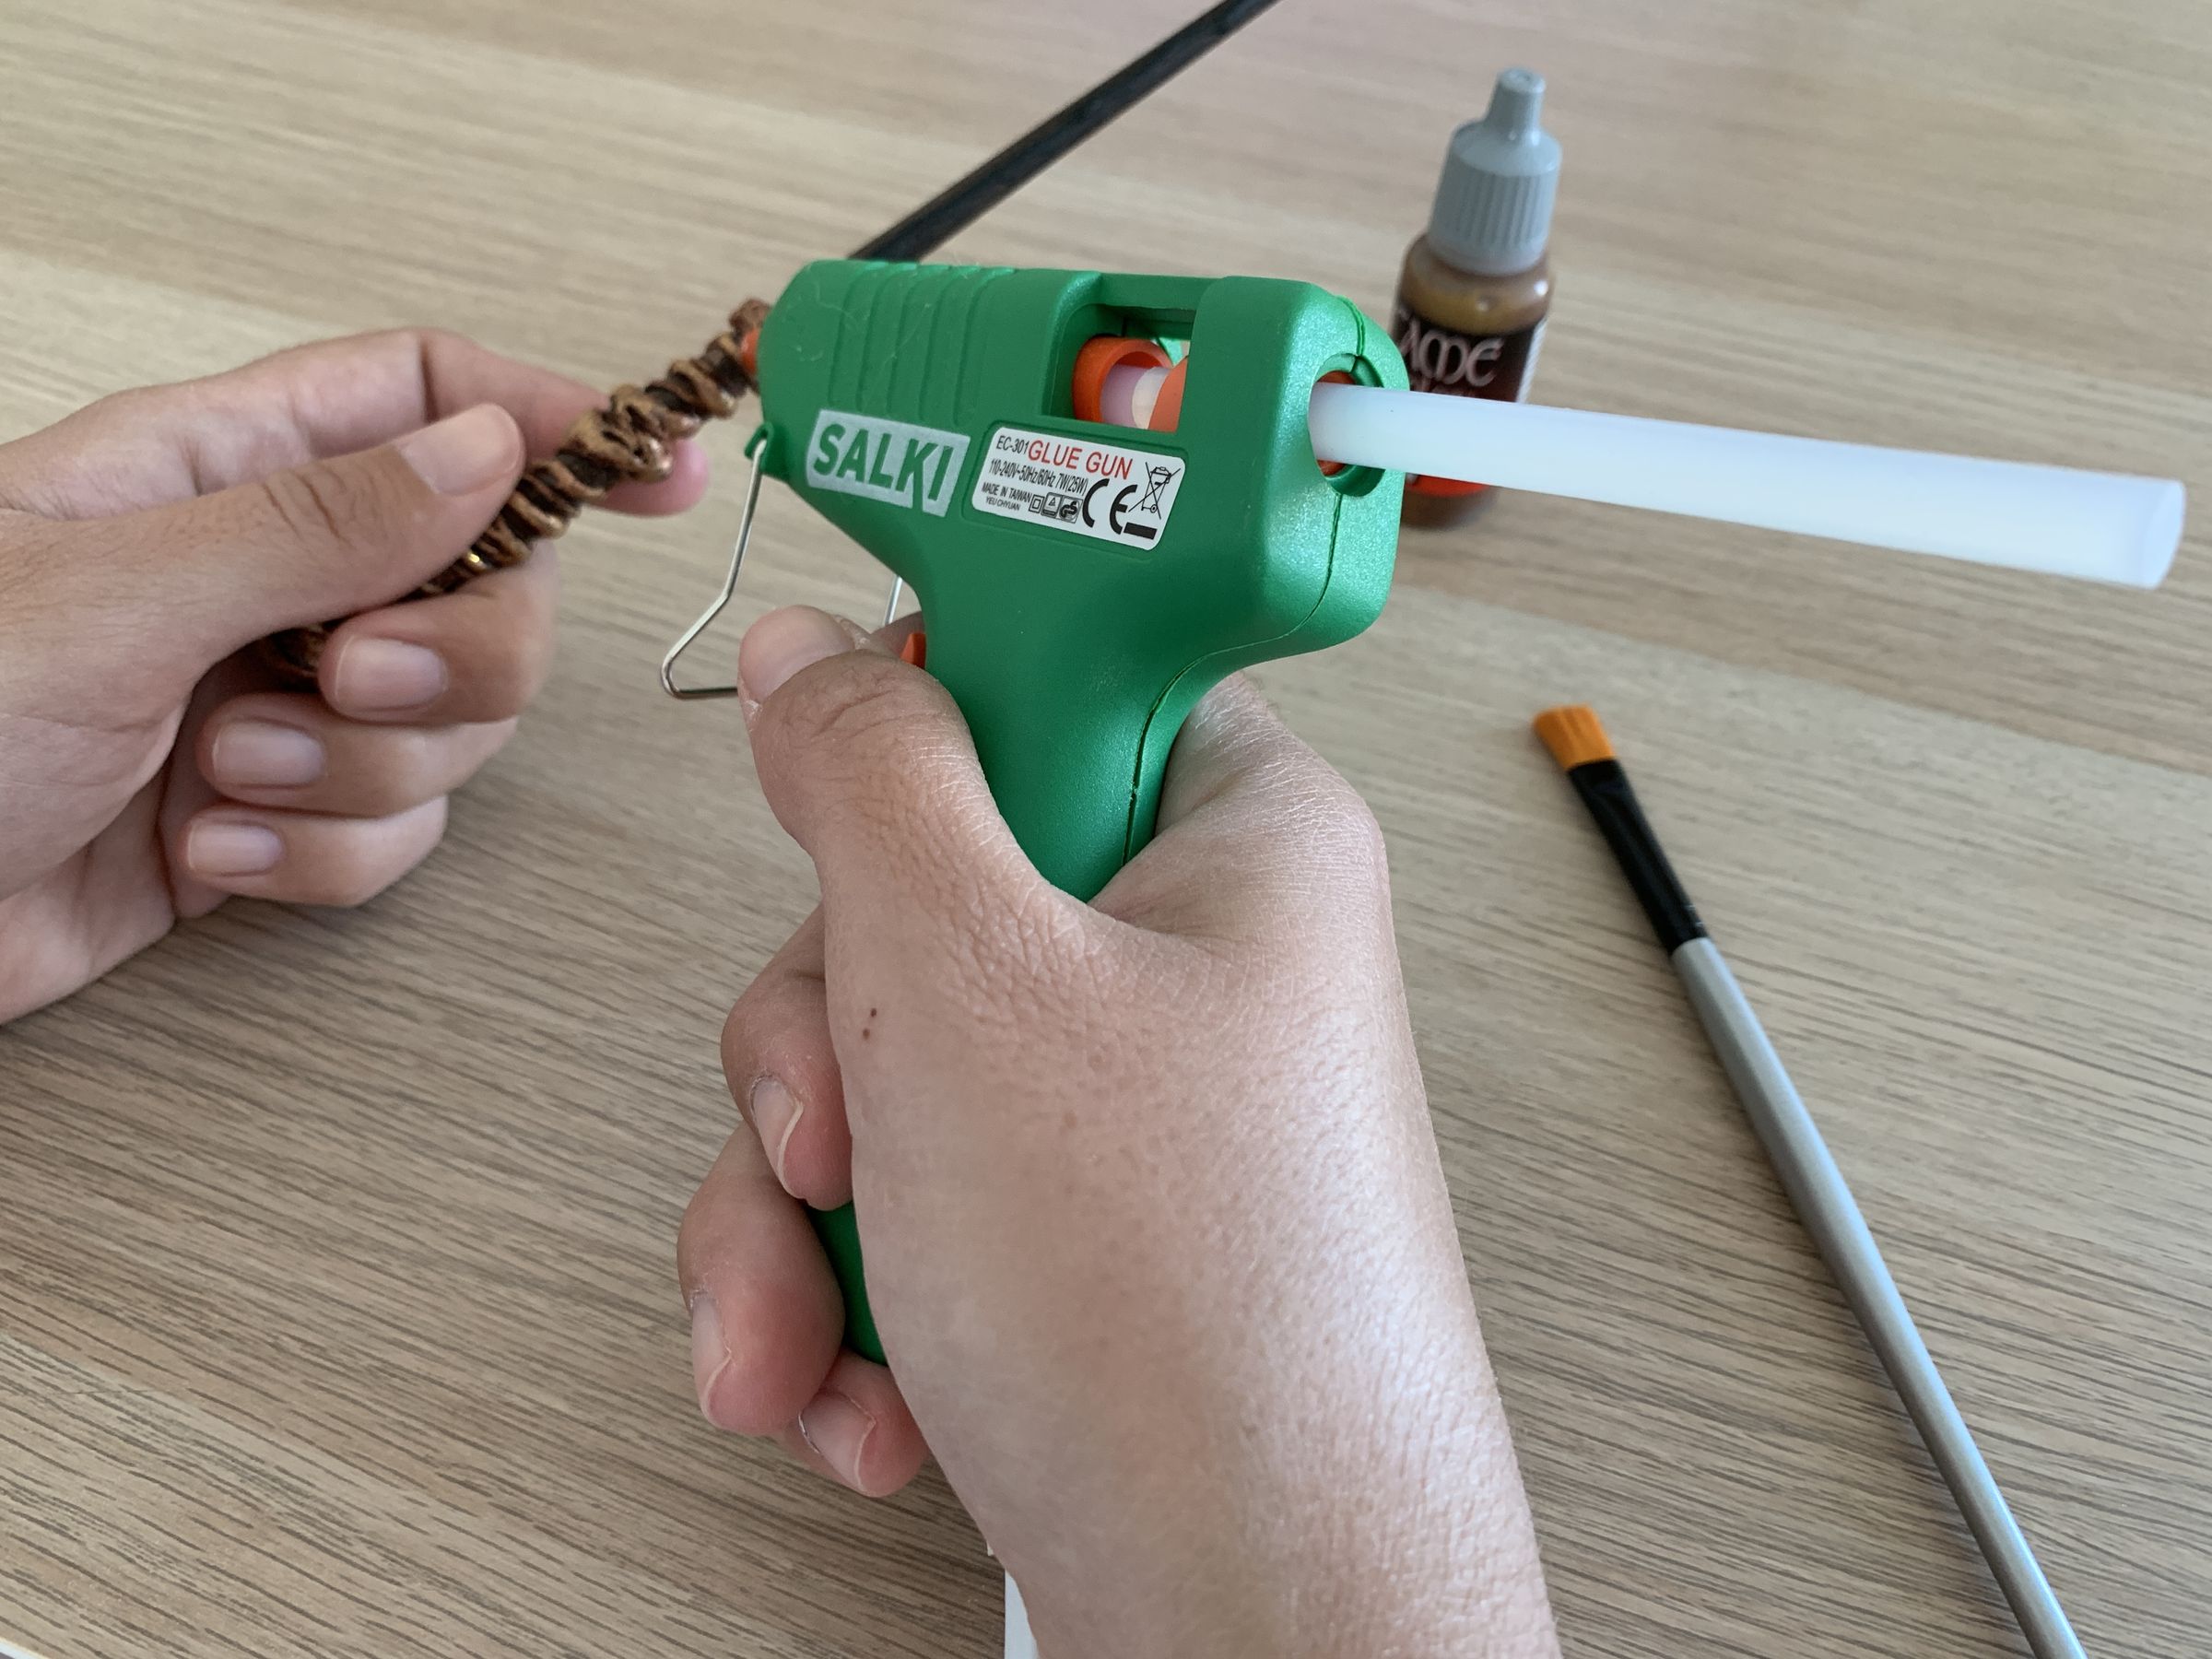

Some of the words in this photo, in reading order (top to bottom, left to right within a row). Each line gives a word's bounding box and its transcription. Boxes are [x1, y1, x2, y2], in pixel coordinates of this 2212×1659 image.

[813, 423, 954, 509] SALKI
[996, 435, 1029, 454] EC-301
[1029, 440, 1083, 469] GLUE
[1086, 452, 1134, 480] GUN
[982, 481, 1000, 496] MADE
[1000, 486, 1009, 497] IN
[1008, 488, 1032, 503] TAIWAN
[1056, 473, 1088, 495] 7W(25W)
